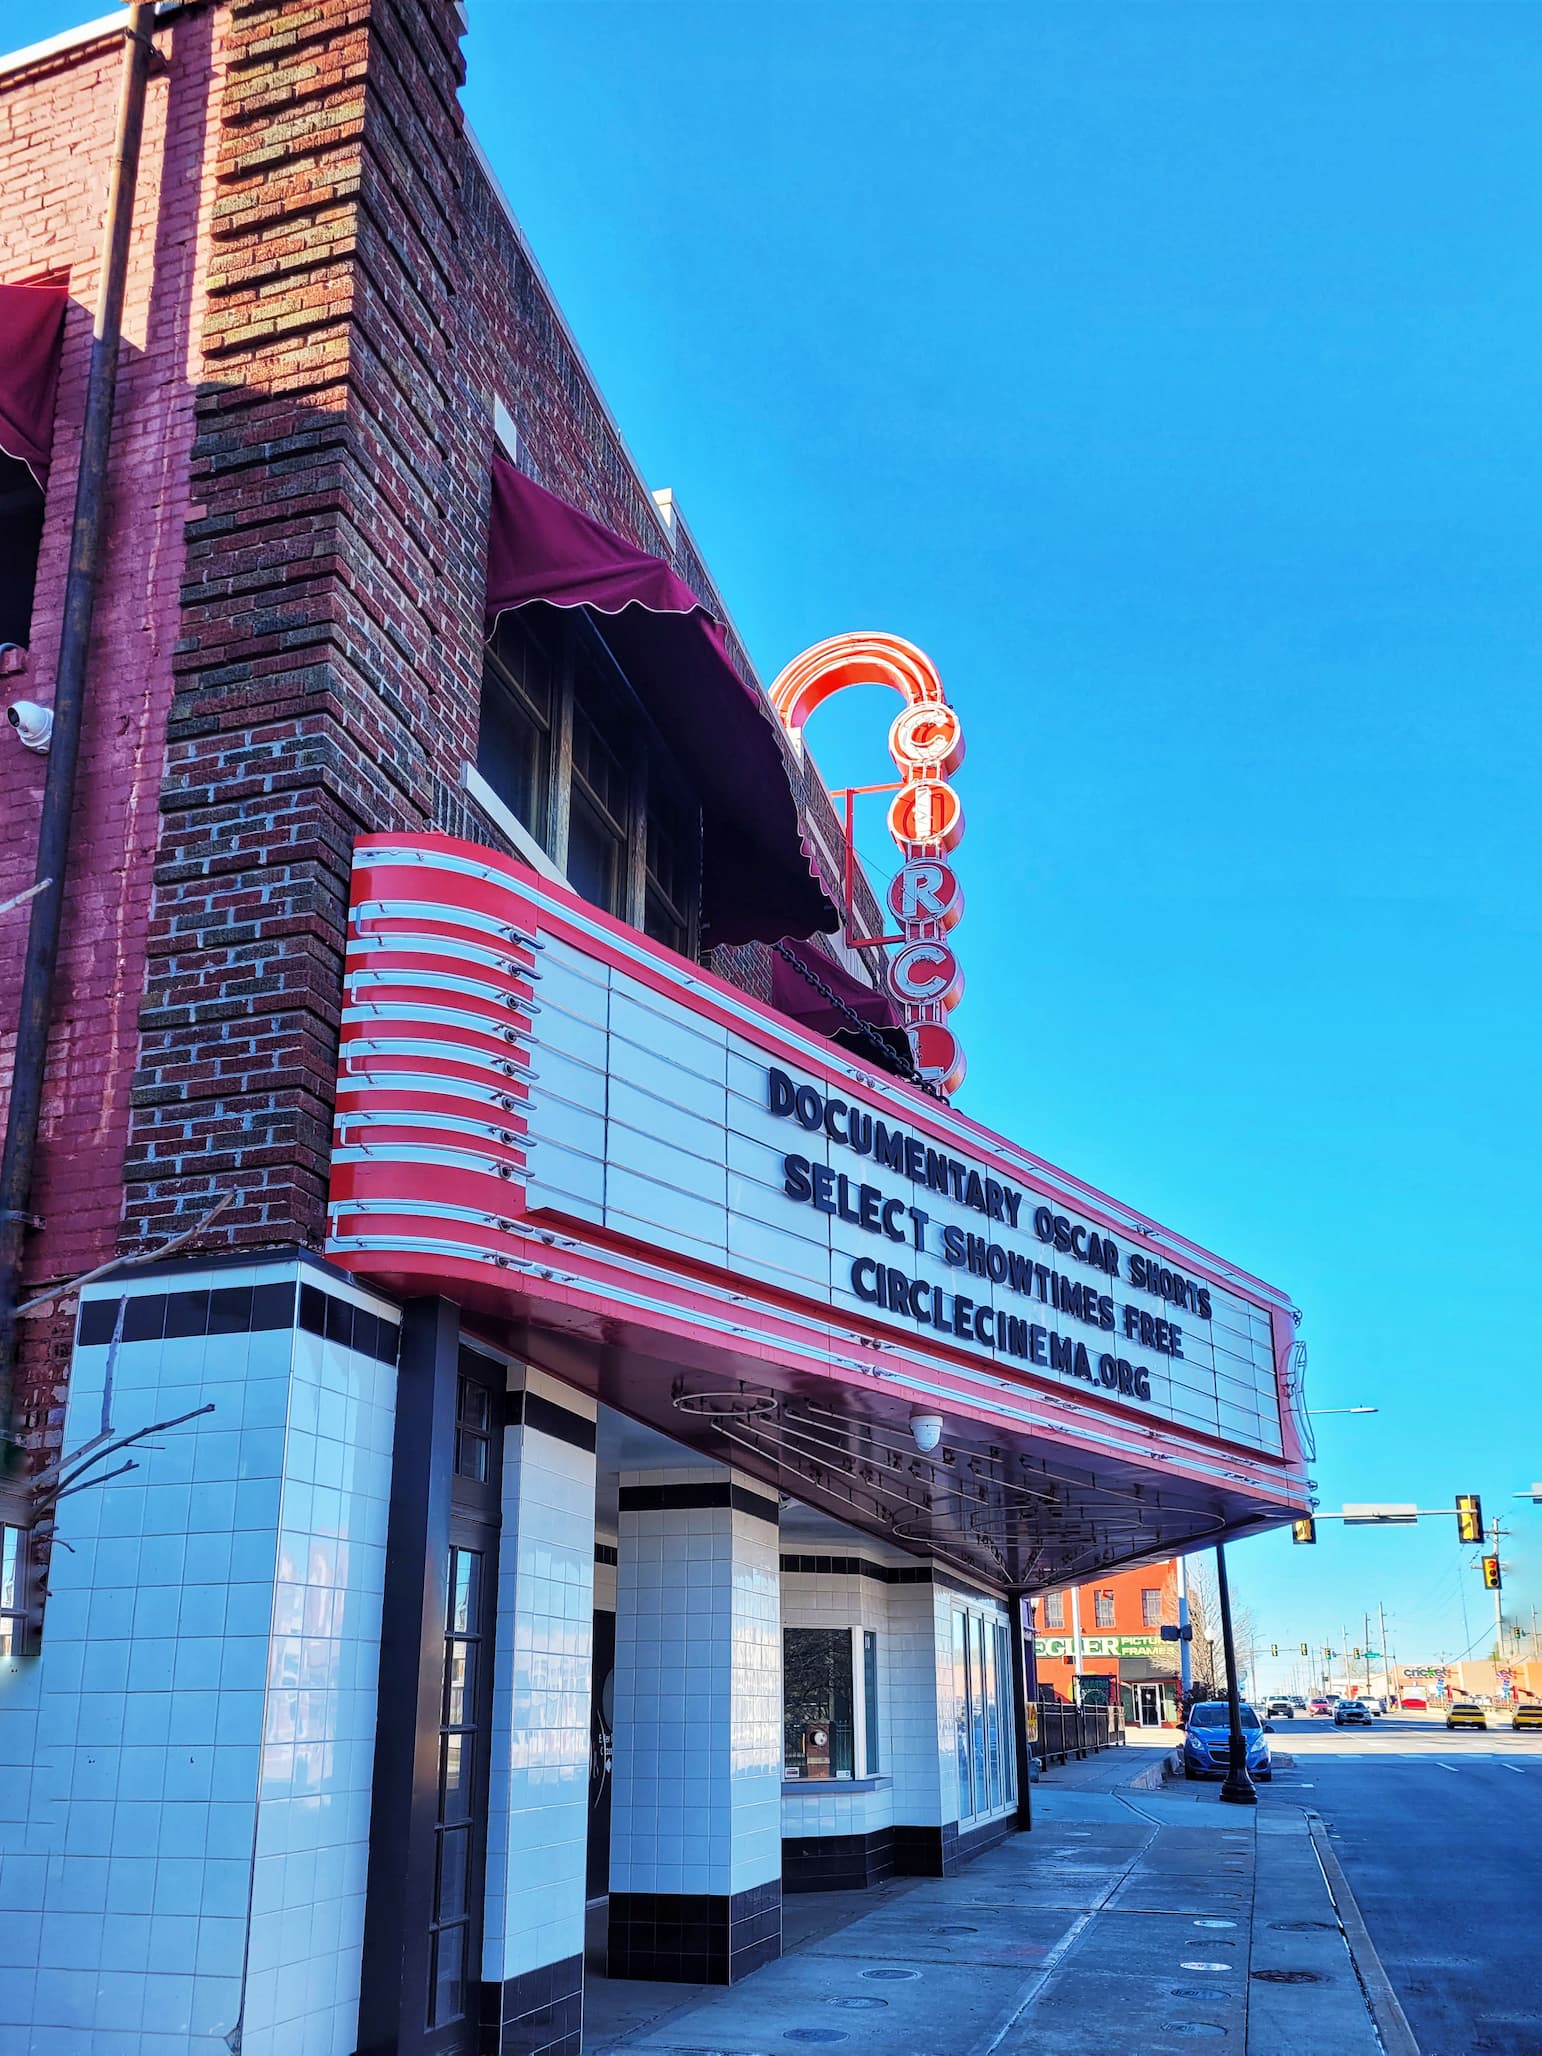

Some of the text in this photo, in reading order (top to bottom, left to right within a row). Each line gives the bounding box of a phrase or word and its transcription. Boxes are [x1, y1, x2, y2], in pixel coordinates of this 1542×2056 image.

[769, 1066, 1213, 1320] DOCUMENTARY OSCAR SHORTS
[784, 1153, 1184, 1360] SELECT SHOWTIMES FREE
[850, 1256, 1152, 1401] CIRCLECINEMA.ORG
[1403, 1666, 1449, 1677] cricket
